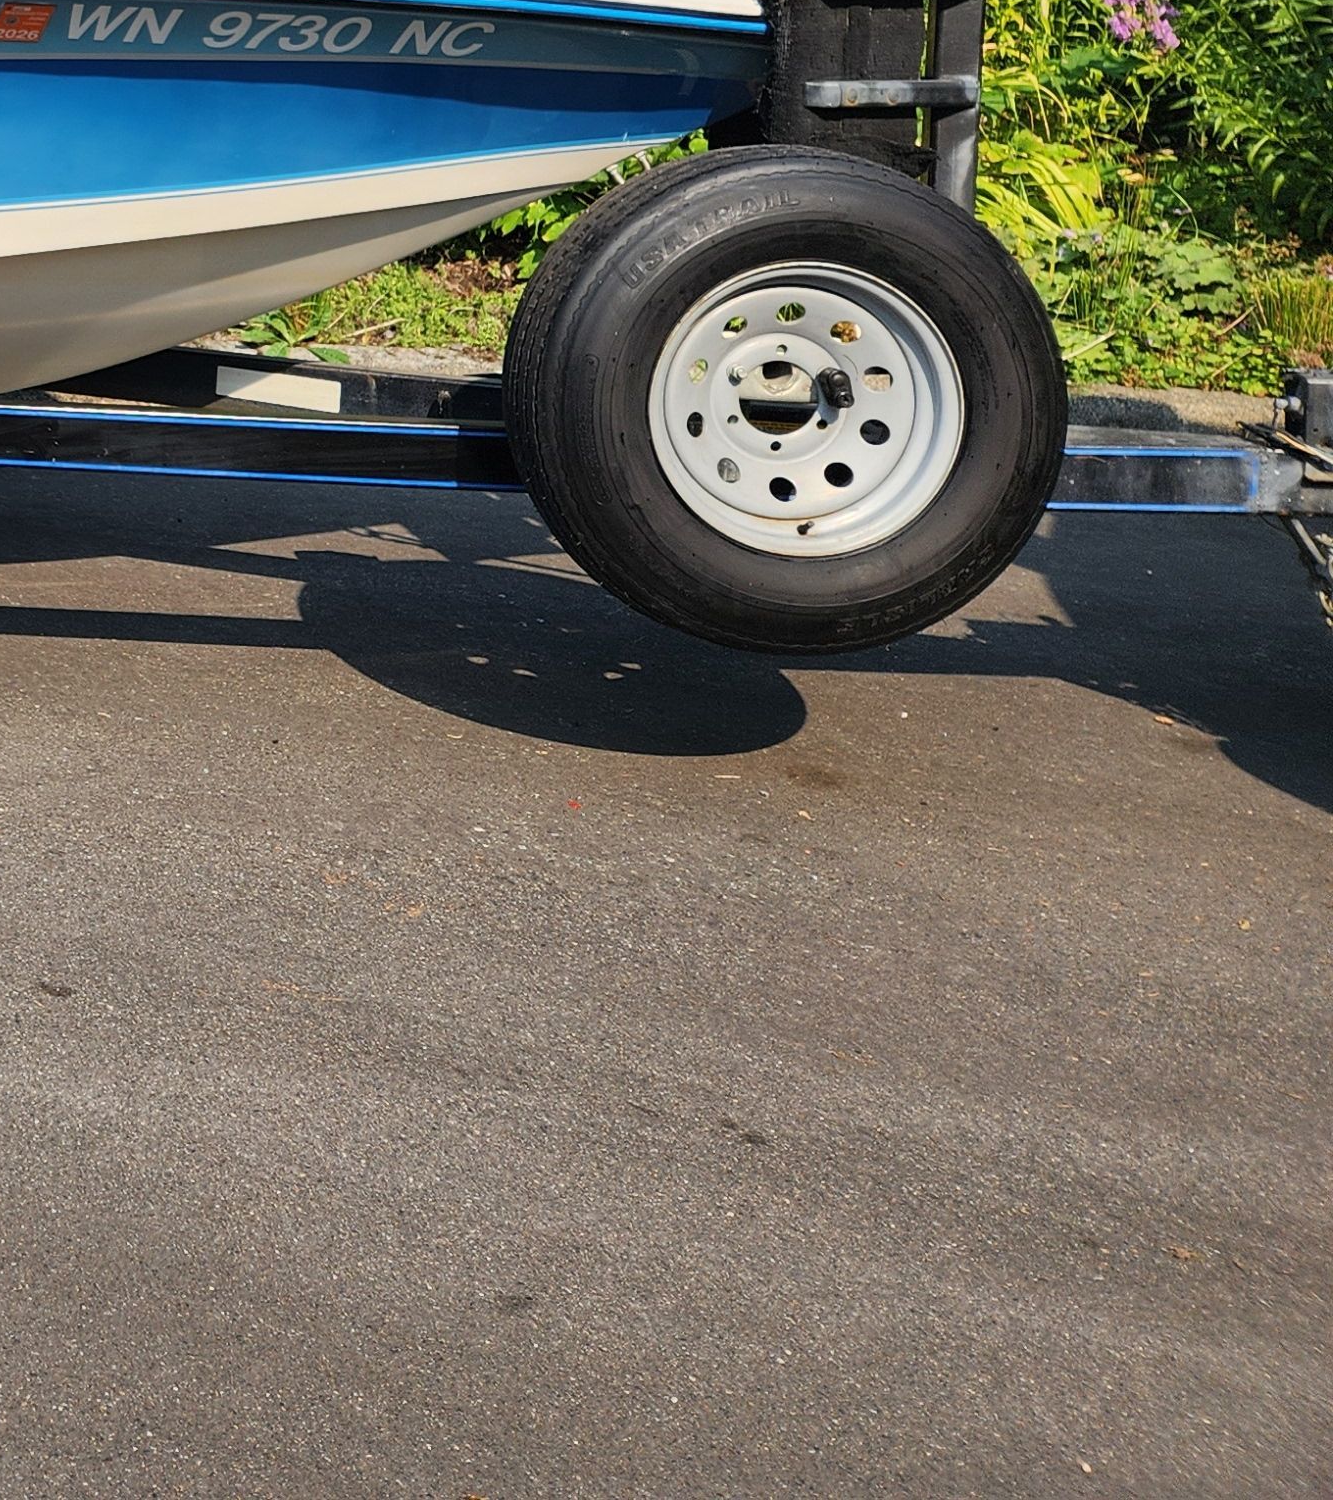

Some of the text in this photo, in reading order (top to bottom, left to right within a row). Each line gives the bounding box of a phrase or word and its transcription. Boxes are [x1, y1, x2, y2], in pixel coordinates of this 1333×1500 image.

[67, 4, 182, 45] WN
[202, 11, 373, 54] 9730
[388, 19, 495, 57] NC
[619, 229, 690, 290] USA
